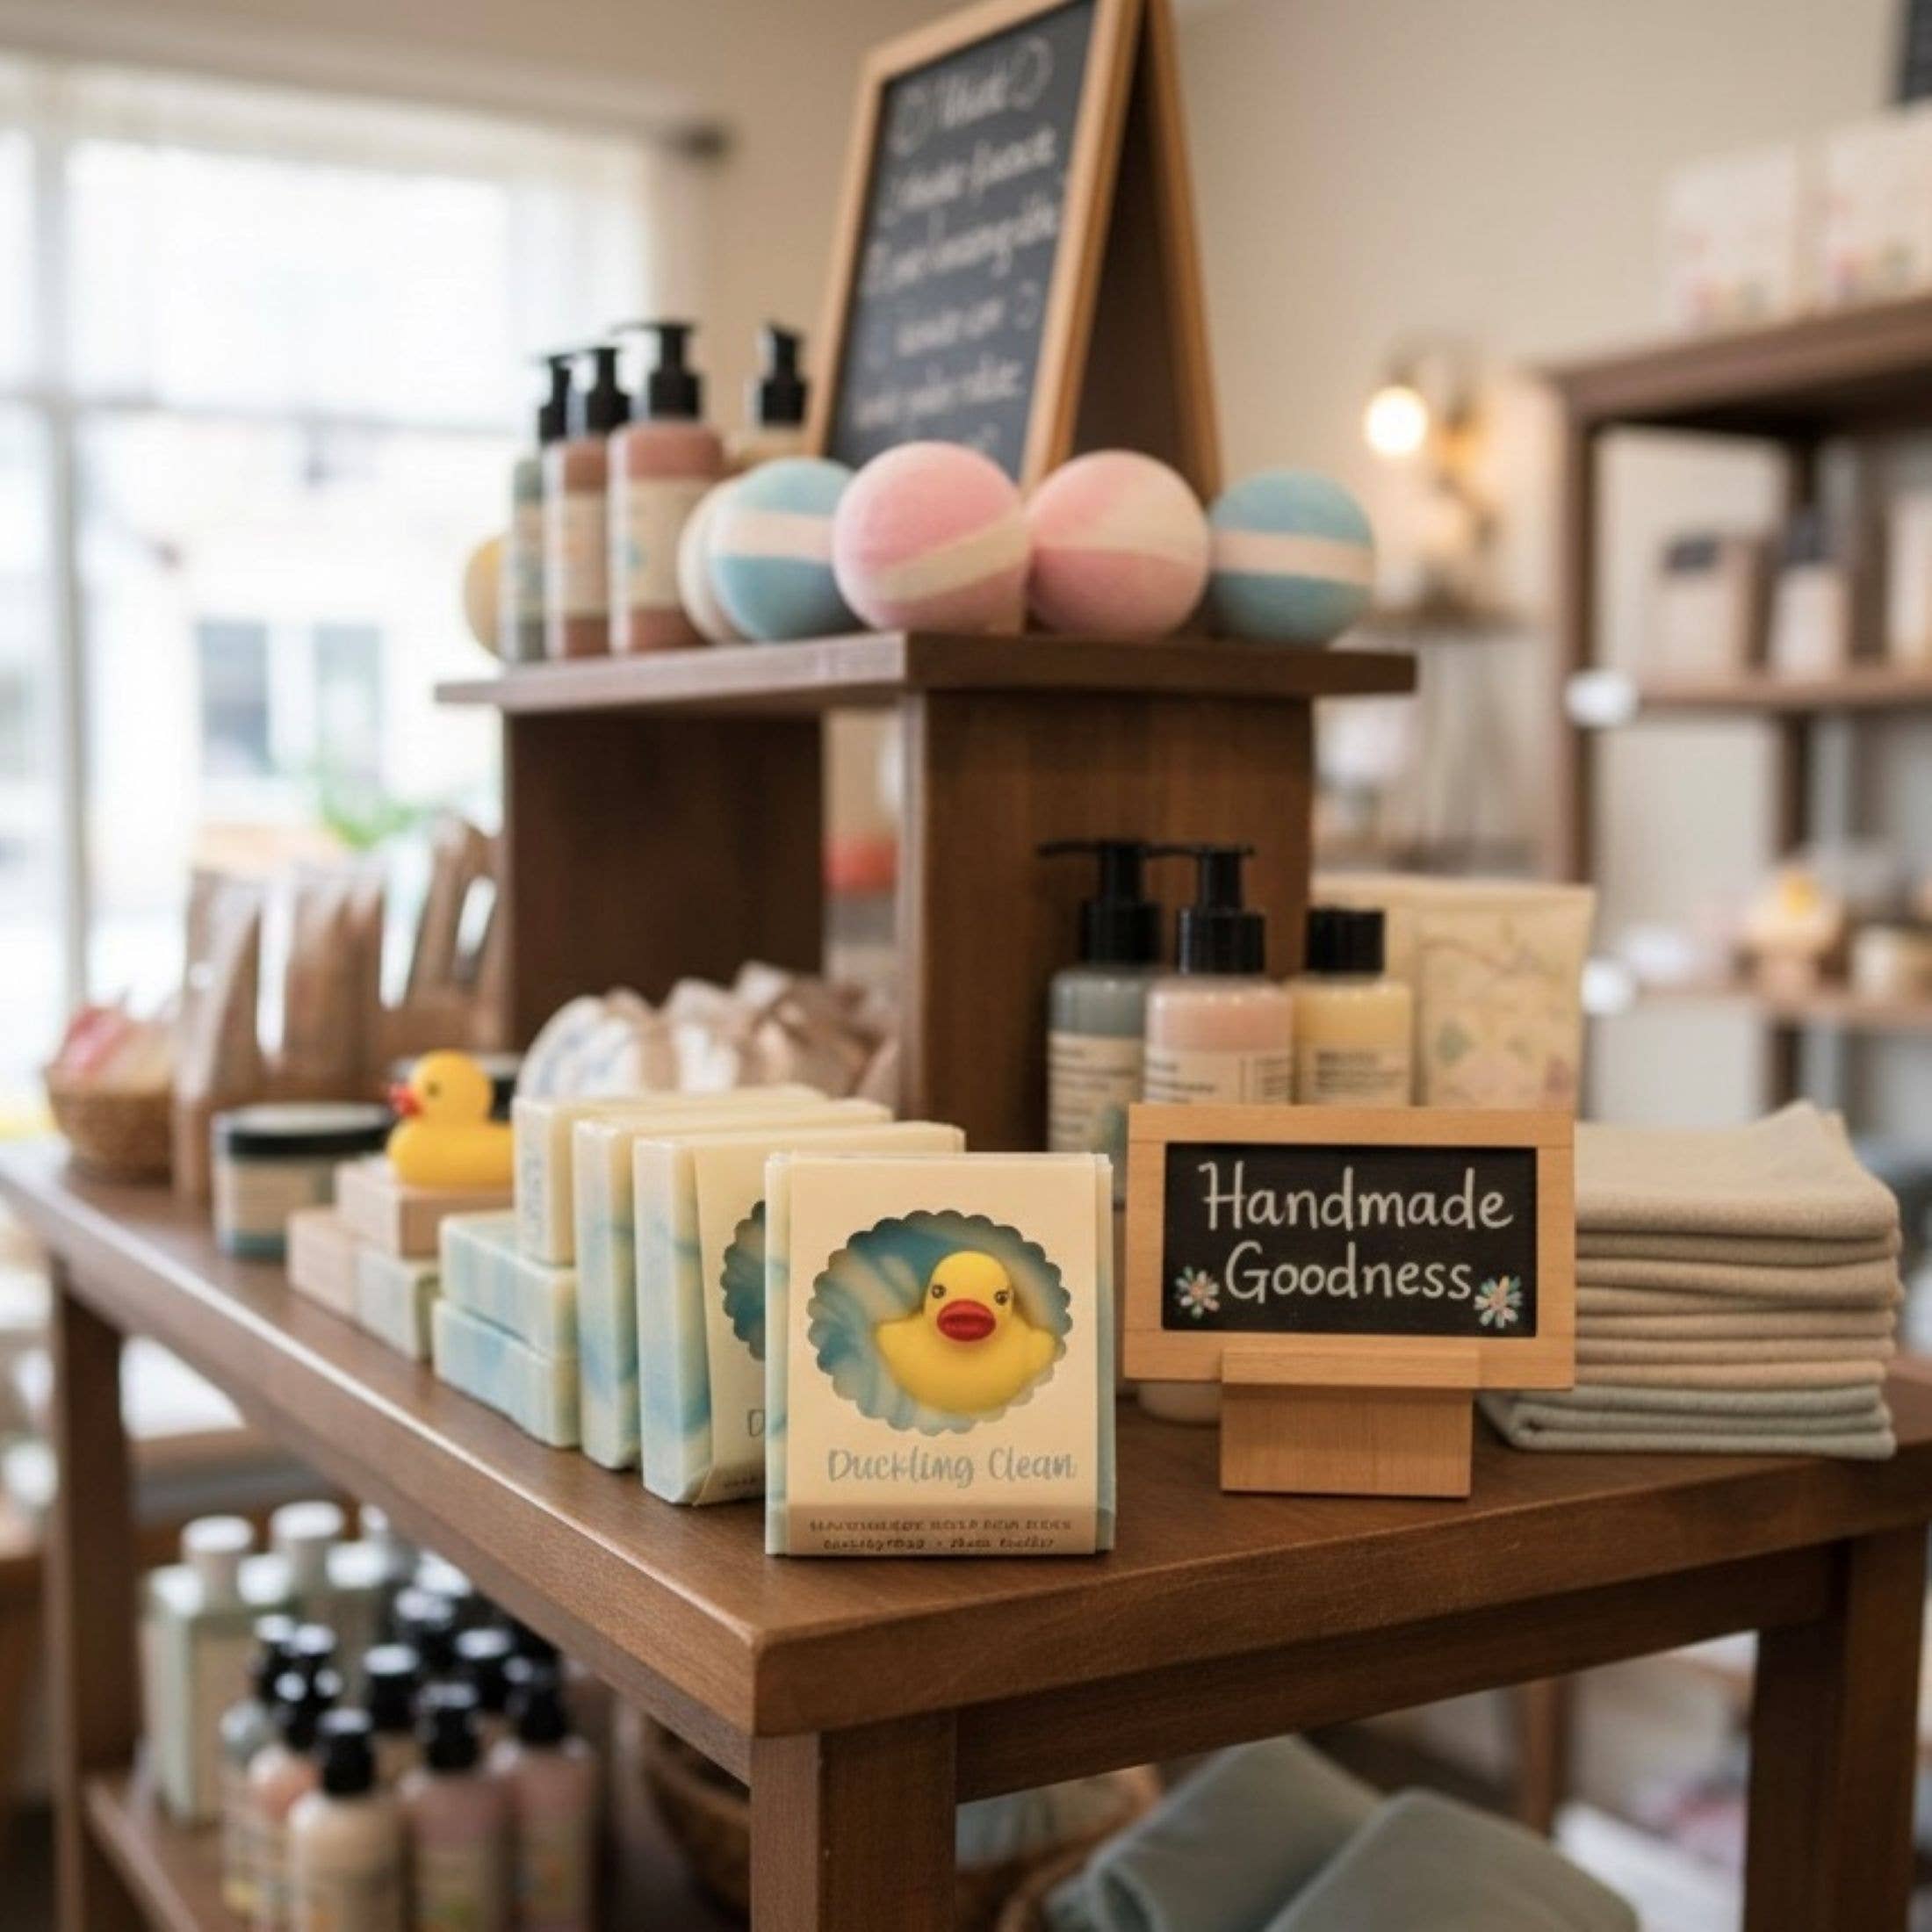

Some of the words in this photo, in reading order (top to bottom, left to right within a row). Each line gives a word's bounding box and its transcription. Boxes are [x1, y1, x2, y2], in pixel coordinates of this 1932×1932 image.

[1199, 1160, 1514, 1231] Handmade
[1226, 1240, 1474, 1304] Goodness
[827, 1446, 975, 1489] Duckling
[989, 1447, 1078, 1481] Clean
